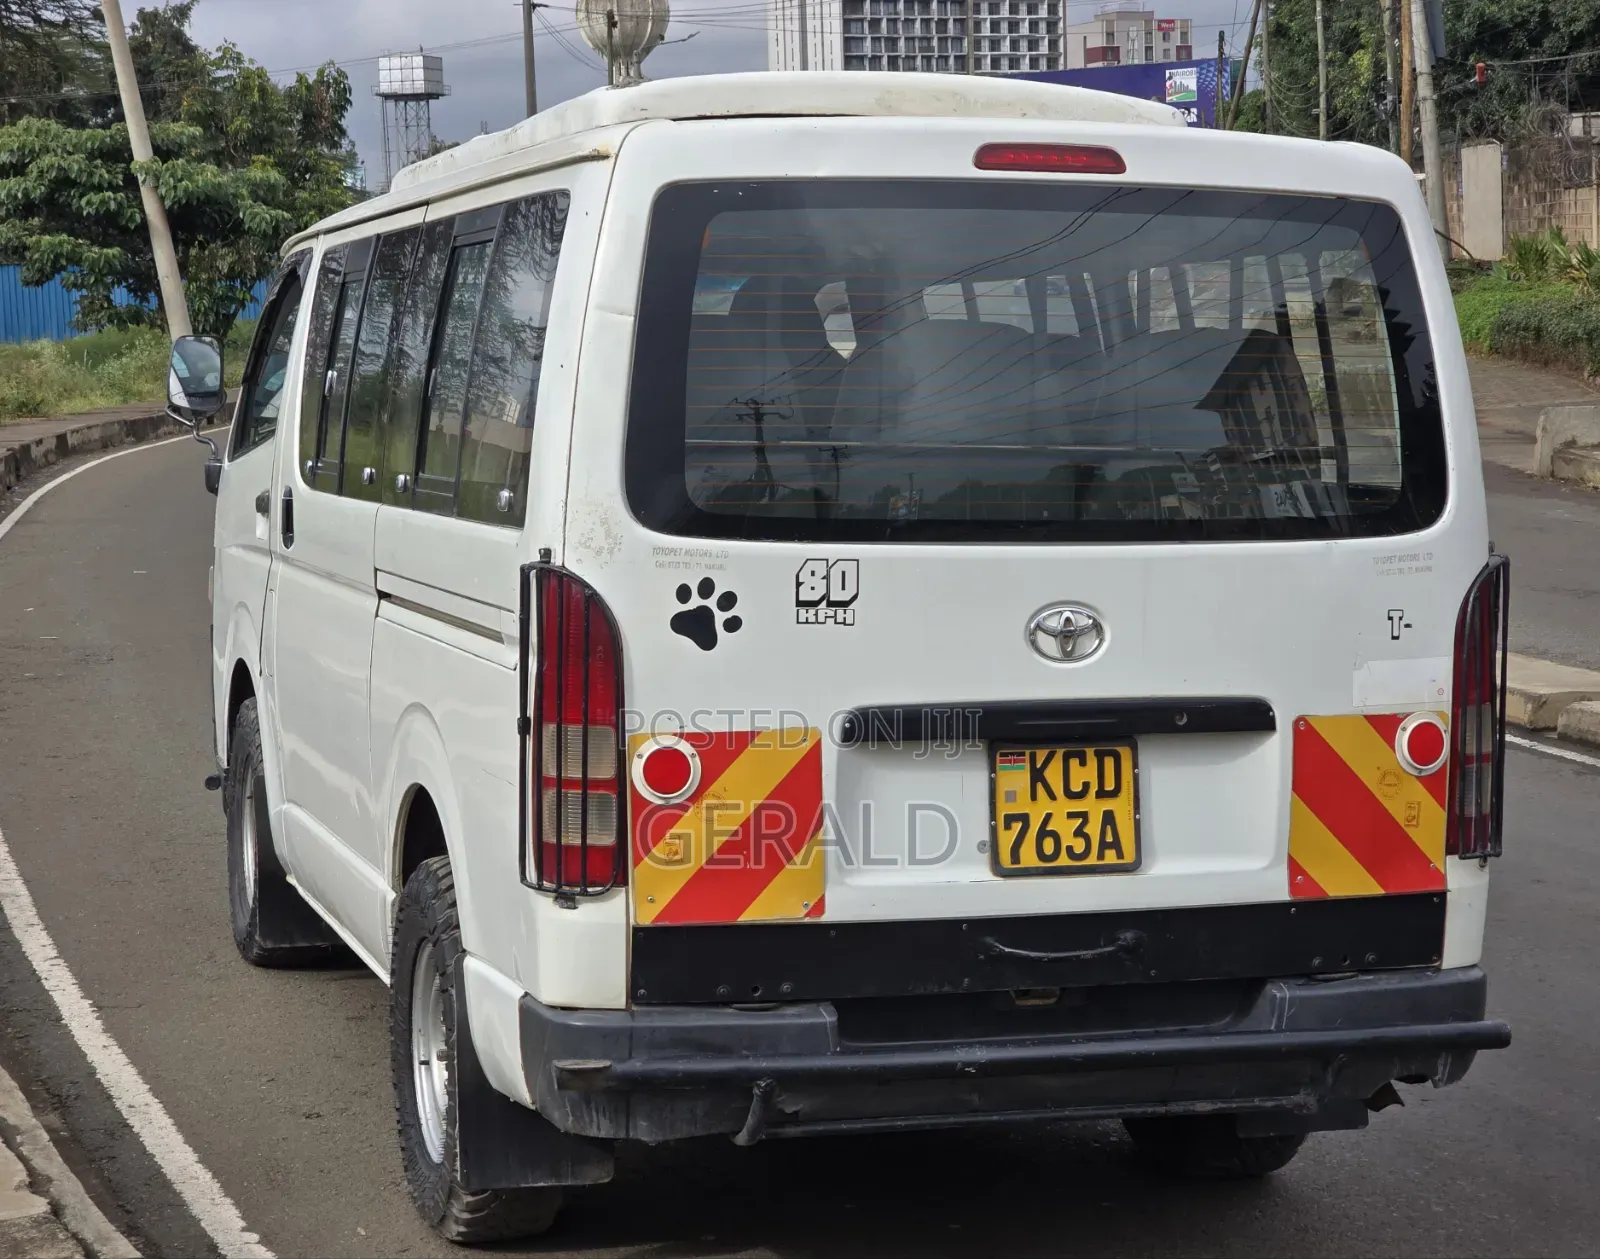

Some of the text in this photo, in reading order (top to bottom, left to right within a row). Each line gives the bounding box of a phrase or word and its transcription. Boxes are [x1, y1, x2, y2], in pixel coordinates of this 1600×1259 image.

[684, 548, 713, 558] MOTORS
[716, 550, 729, 559] LTD
[1423, 552, 1434, 561] LTD
[795, 558, 860, 608] 80
[796, 607, 855, 626] KPH
[1028, 748, 1122, 802] KCD
[1003, 809, 1125, 865] 763A
